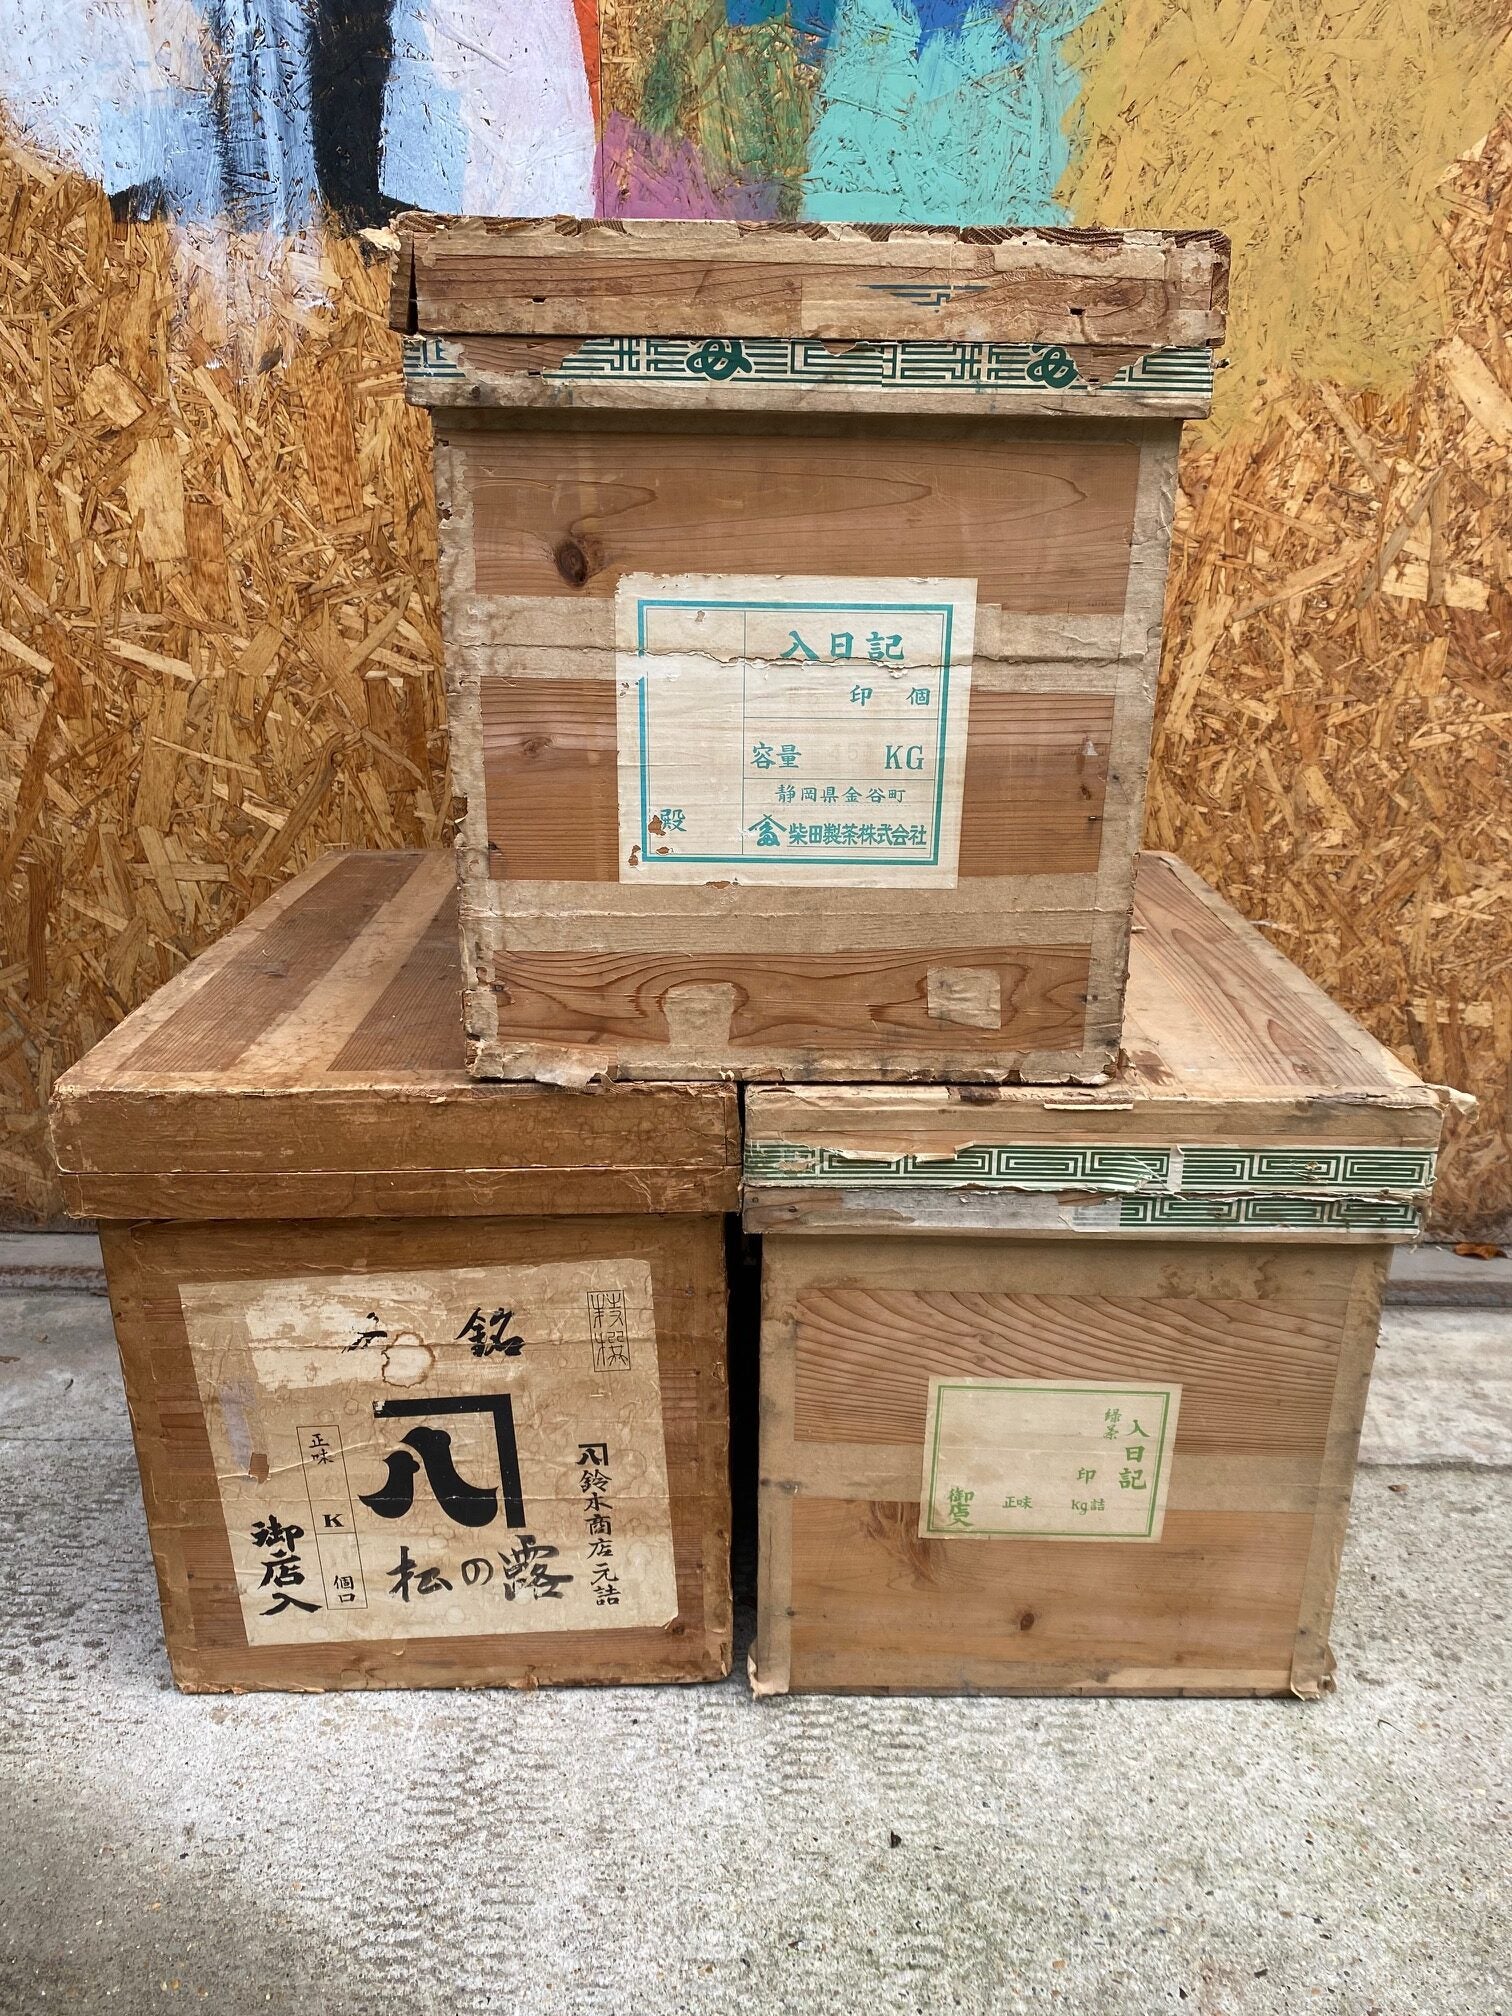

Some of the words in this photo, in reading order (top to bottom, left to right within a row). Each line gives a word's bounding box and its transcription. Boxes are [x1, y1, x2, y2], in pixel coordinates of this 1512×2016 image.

[780, 631, 905, 661] 入日記
[850, 685, 873, 706] 印
[906, 687, 931, 706] 個
[751, 741, 802, 769] 容量
[884, 745, 925, 770] KG
[775, 784, 906, 804] 静岡県金谷町
[660, 808, 687, 832] 殿
[788, 823, 927, 846] 柴田製茶株式会社
[1119, 1419, 1151, 1490] 入日記
[309, 1433, 334, 1465] 正味
[322, 1513, 344, 1528] K
[1076, 1467, 1096, 1485] 印
[1002, 1496, 1032, 1509] 正味
[250, 1514, 323, 1616] 御店入
[333, 1574, 356, 1603] 個口
